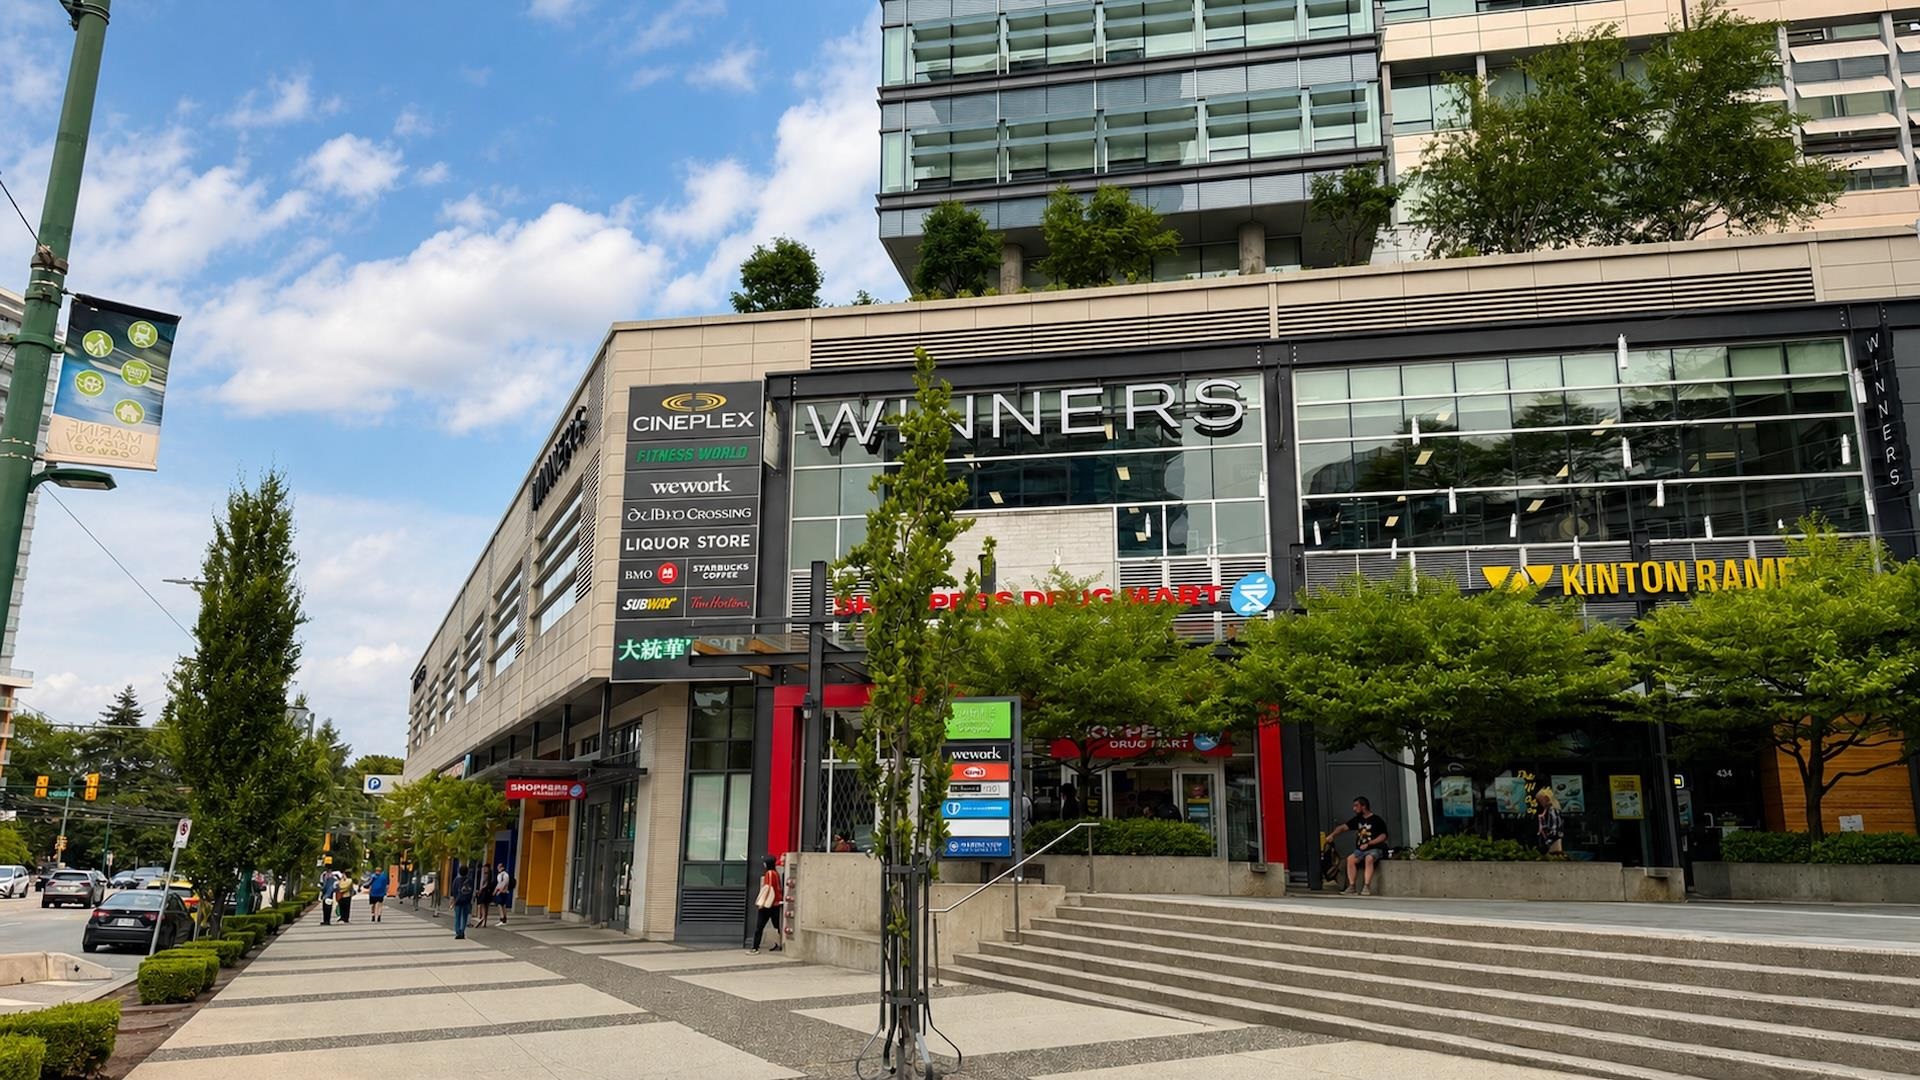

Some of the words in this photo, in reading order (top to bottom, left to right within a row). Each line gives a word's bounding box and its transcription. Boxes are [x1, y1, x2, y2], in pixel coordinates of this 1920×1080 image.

[1866, 333, 1900, 486] WINNERS
[632, 411, 755, 432] CINEPLEX
[636, 448, 694, 463] FITNESS
[698, 446, 748, 461] WORLD
[650, 473, 732, 495] wework
[625, 537, 690, 551] LIQUOR
[697, 534, 751, 549] STORE
[625, 569, 653, 580] BMO
[692, 563, 750, 573] STARBUCKS
[702, 571, 739, 580] COFFEE
[1561, 561, 1689, 596] KINTON
[1694, 557, 1801, 594] RAME
[622, 597, 677, 611] SUBWAY
[618, 638, 685, 661] 大統華
[951, 746, 1002, 760] wework
[1109, 740, 1148, 749] DRUG
